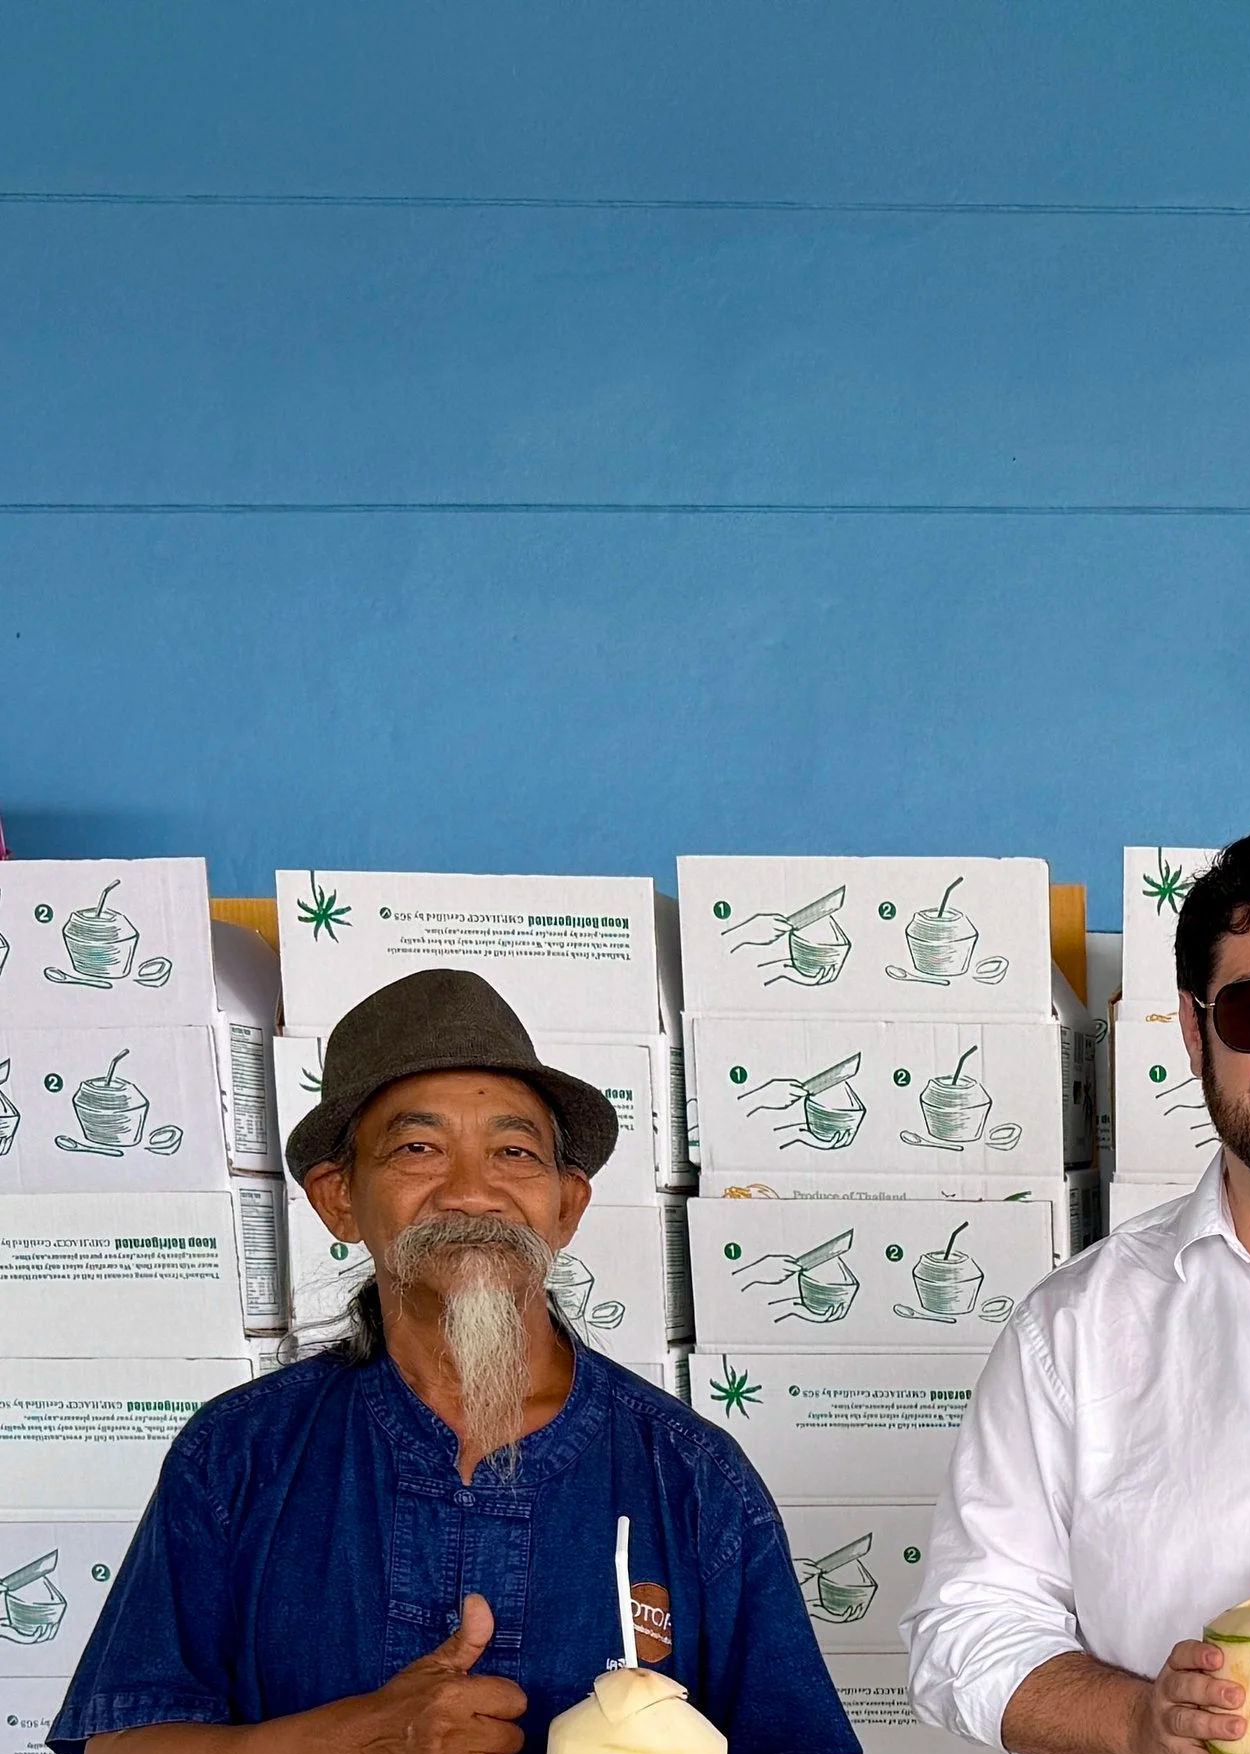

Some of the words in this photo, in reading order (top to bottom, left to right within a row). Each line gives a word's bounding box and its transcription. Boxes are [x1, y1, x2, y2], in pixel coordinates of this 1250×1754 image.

[394, 913, 412, 921] SGS
[414, 911, 424, 921] by
[426, 913, 465, 922] Certified
[528, 916, 599, 928] Refrigerated
[602, 917, 629, 929] Keep
[793, 1191, 839, 1199] Produce
[843, 1192, 854, 1200] of
[857, 1192, 906, 1200] Thailand
[1, 1238, 11, 1248] by
[13, 1239, 51, 1248] Certified
[115, 1237, 185, 1249] Refrigerated
[188, 1237, 216, 1249] Keep
[127, 1401, 199, 1412] Refrigerated
